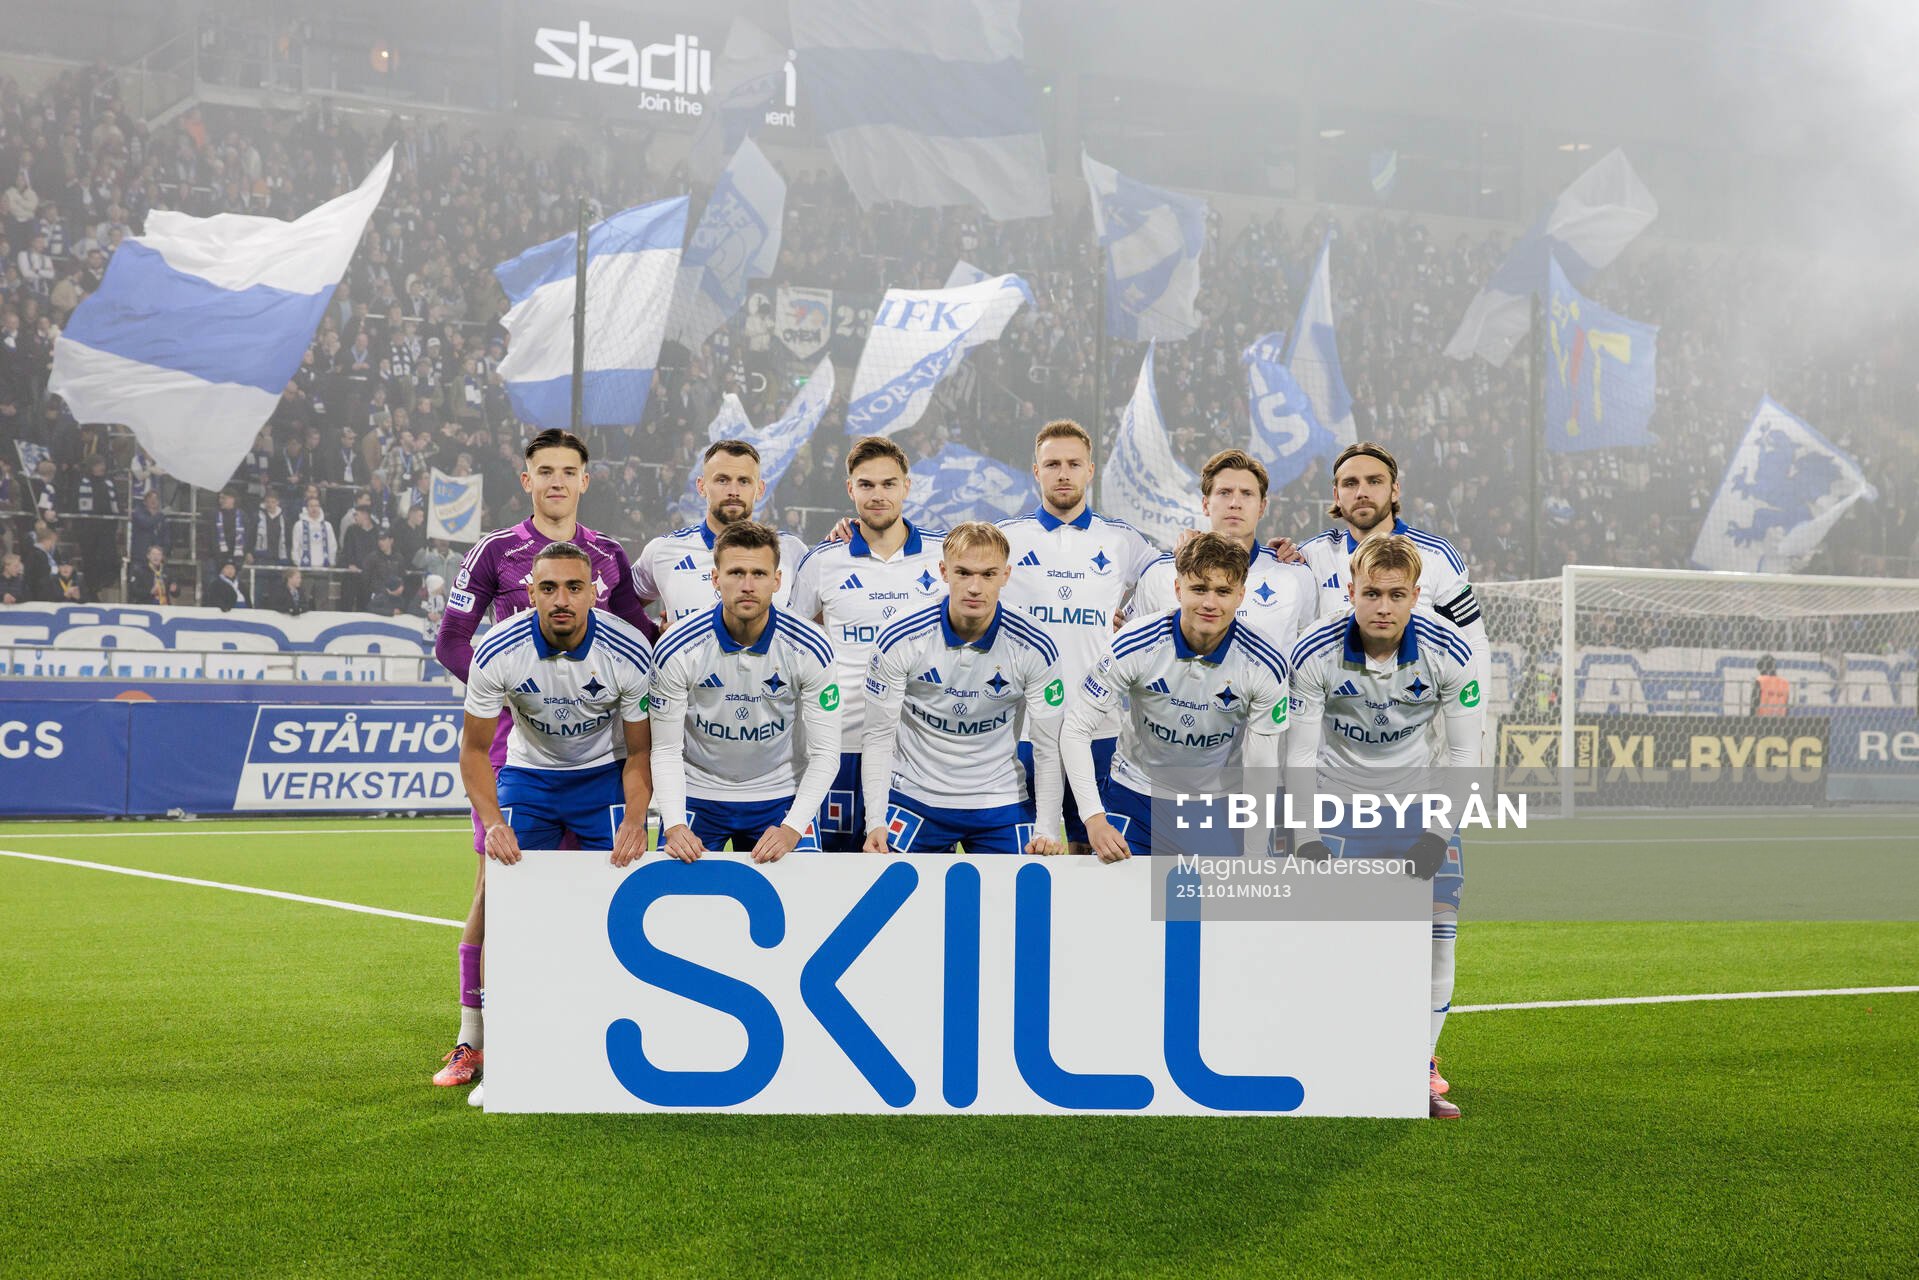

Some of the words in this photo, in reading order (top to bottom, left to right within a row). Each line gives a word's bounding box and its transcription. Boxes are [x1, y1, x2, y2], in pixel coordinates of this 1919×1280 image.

[638, 91, 671, 112] Join
[675, 95, 703, 116] the
[873, 299, 971, 332] IFK
[1046, 569, 1085, 580] stadium
[868, 590, 909, 601] stadium
[1028, 605, 1107, 628] OLMEN
[723, 693, 762, 703] stadium
[943, 686, 979, 699] stadium
[1168, 697, 1209, 712] stadium
[268, 712, 464, 754] STÅTHÖ
[517, 705, 612, 737] HOLMEN
[695, 713, 785, 742] HOLMEN
[910, 703, 1008, 735] HOLMEN
[1143, 715, 1236, 748] HOLMEN
[1605, 734, 1824, 784] XL-BYGG
[261, 770, 455, 800] VERKSTAD
[606, 861, 1305, 1112] SKILL
